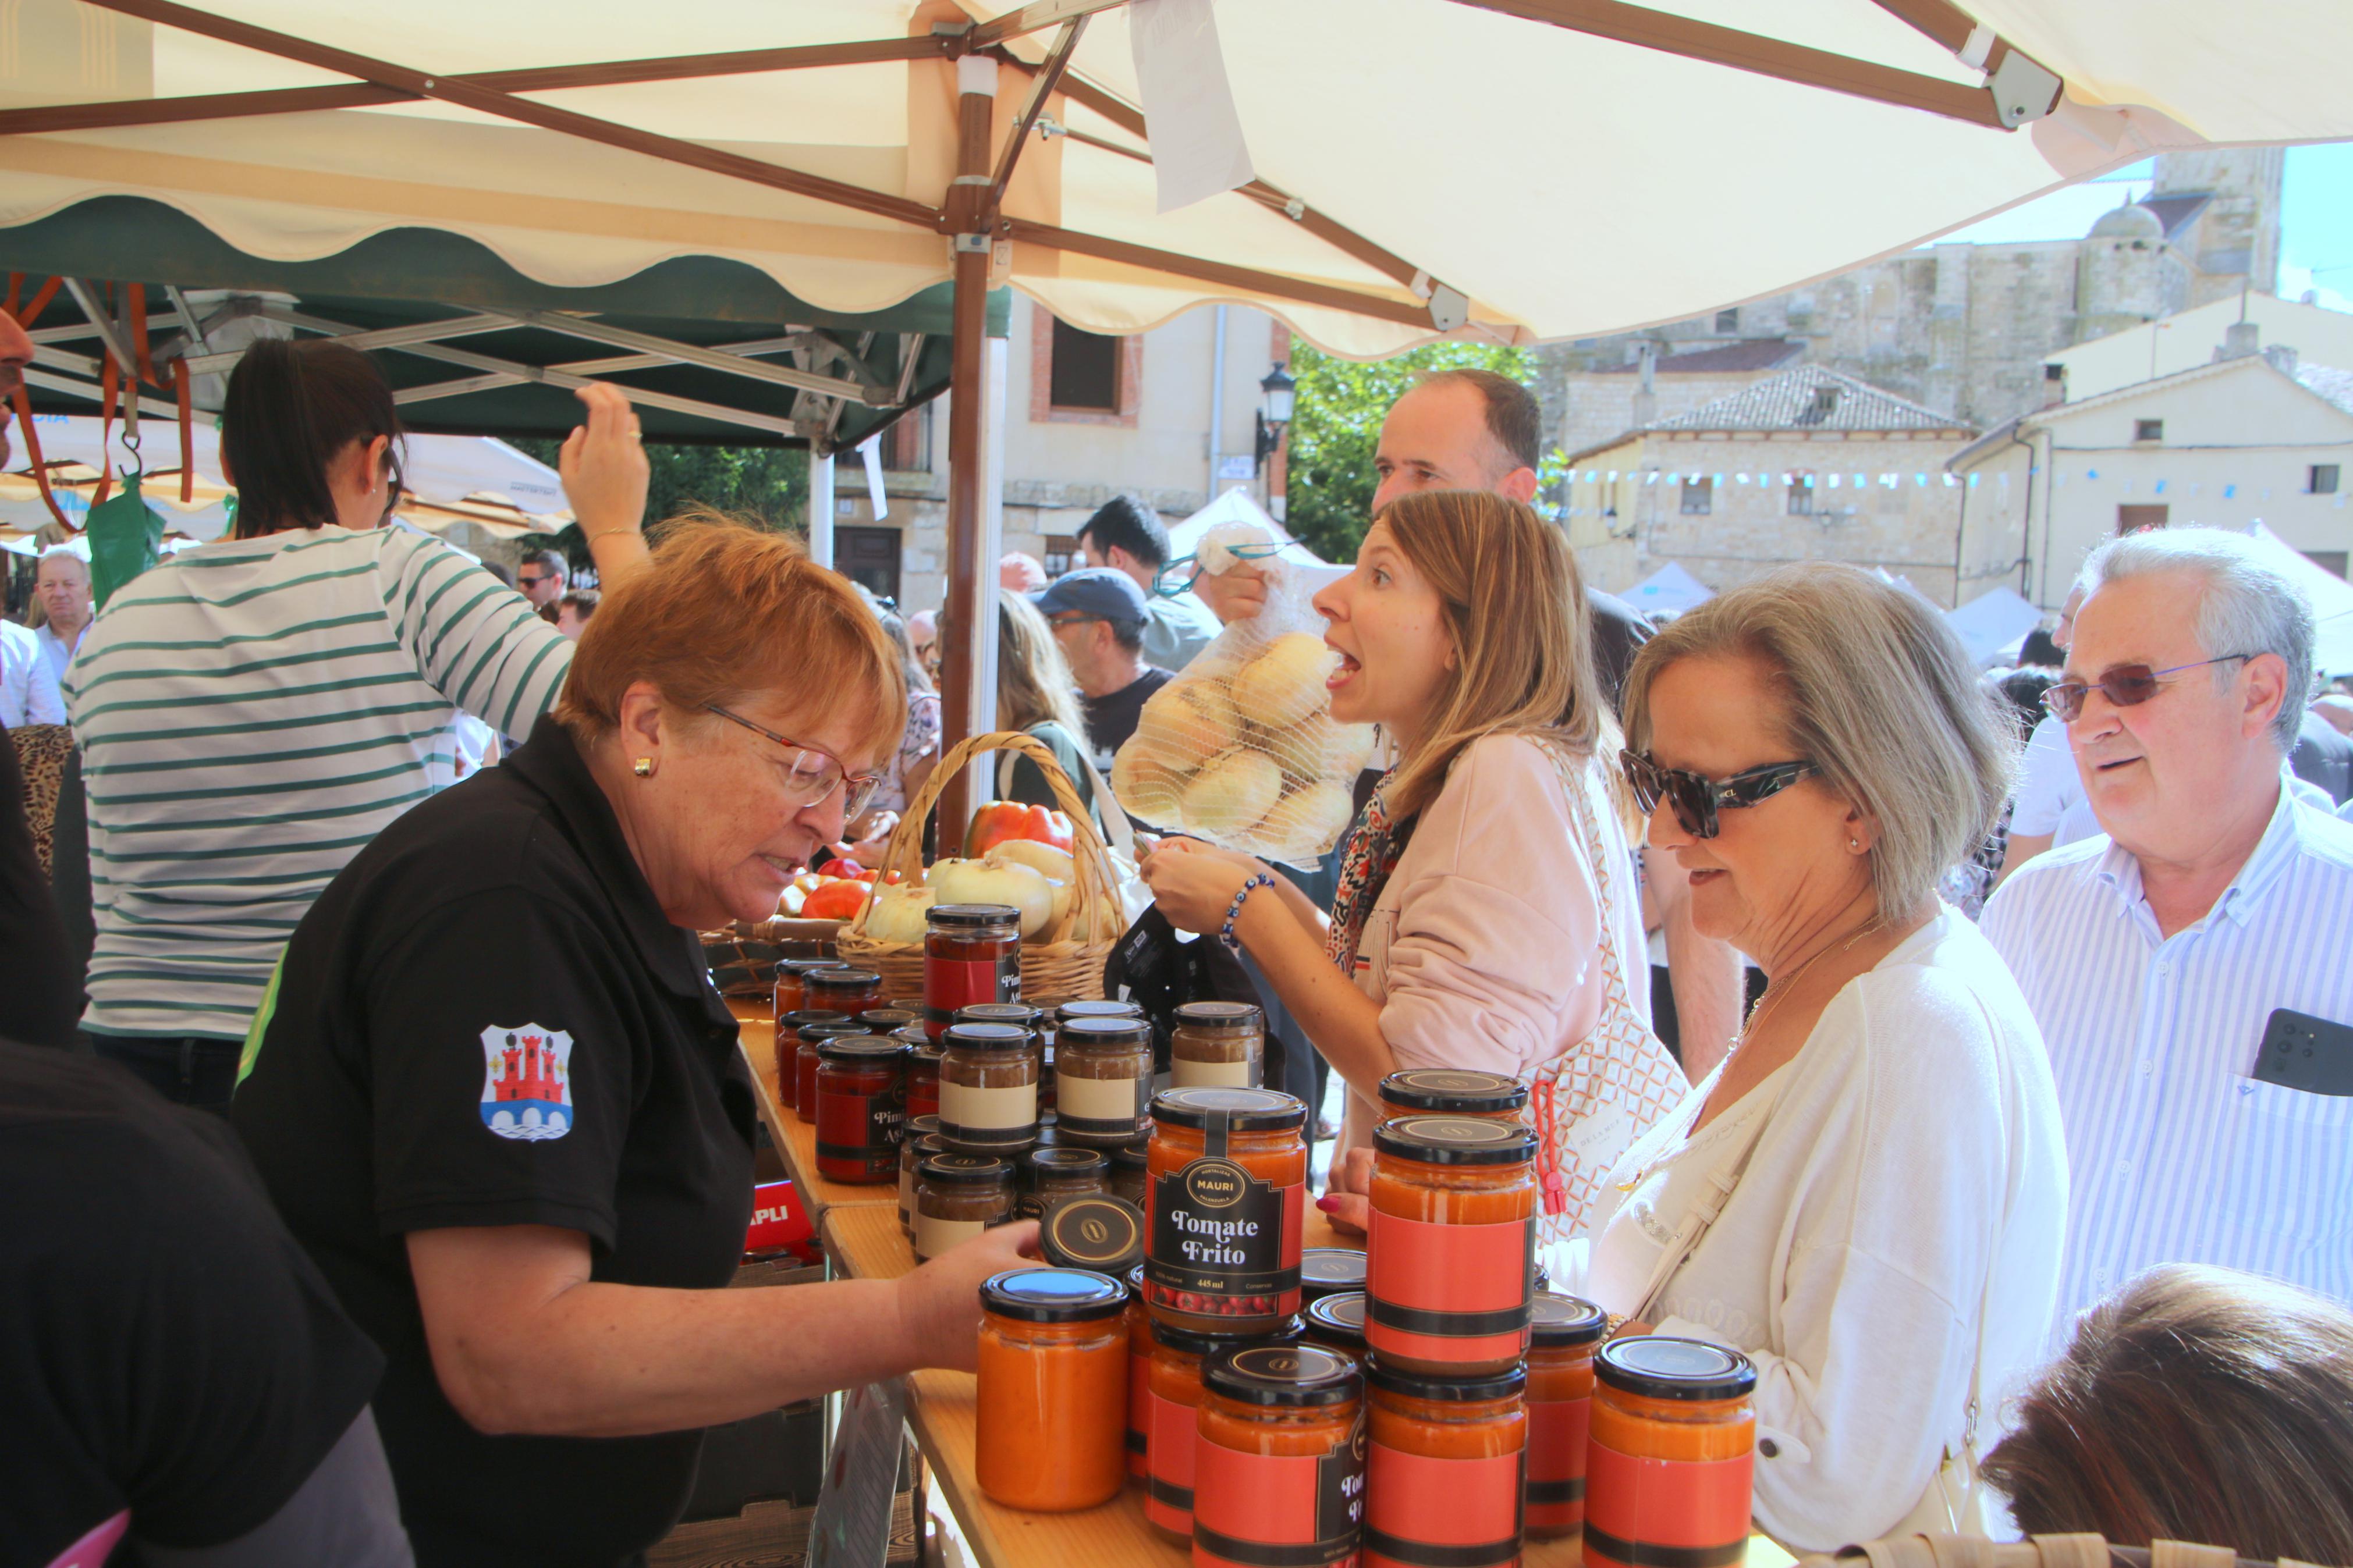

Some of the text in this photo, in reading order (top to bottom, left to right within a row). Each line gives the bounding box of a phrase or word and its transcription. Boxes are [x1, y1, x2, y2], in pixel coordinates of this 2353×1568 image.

[1197, 1180, 1234, 1192] MAURI
[1171, 1210, 1259, 1243] Tomate
[1181, 1240, 1246, 1264] Frito
[1197, 1279, 1211, 1288] 445
[1212, 1281, 1224, 1289] ml
